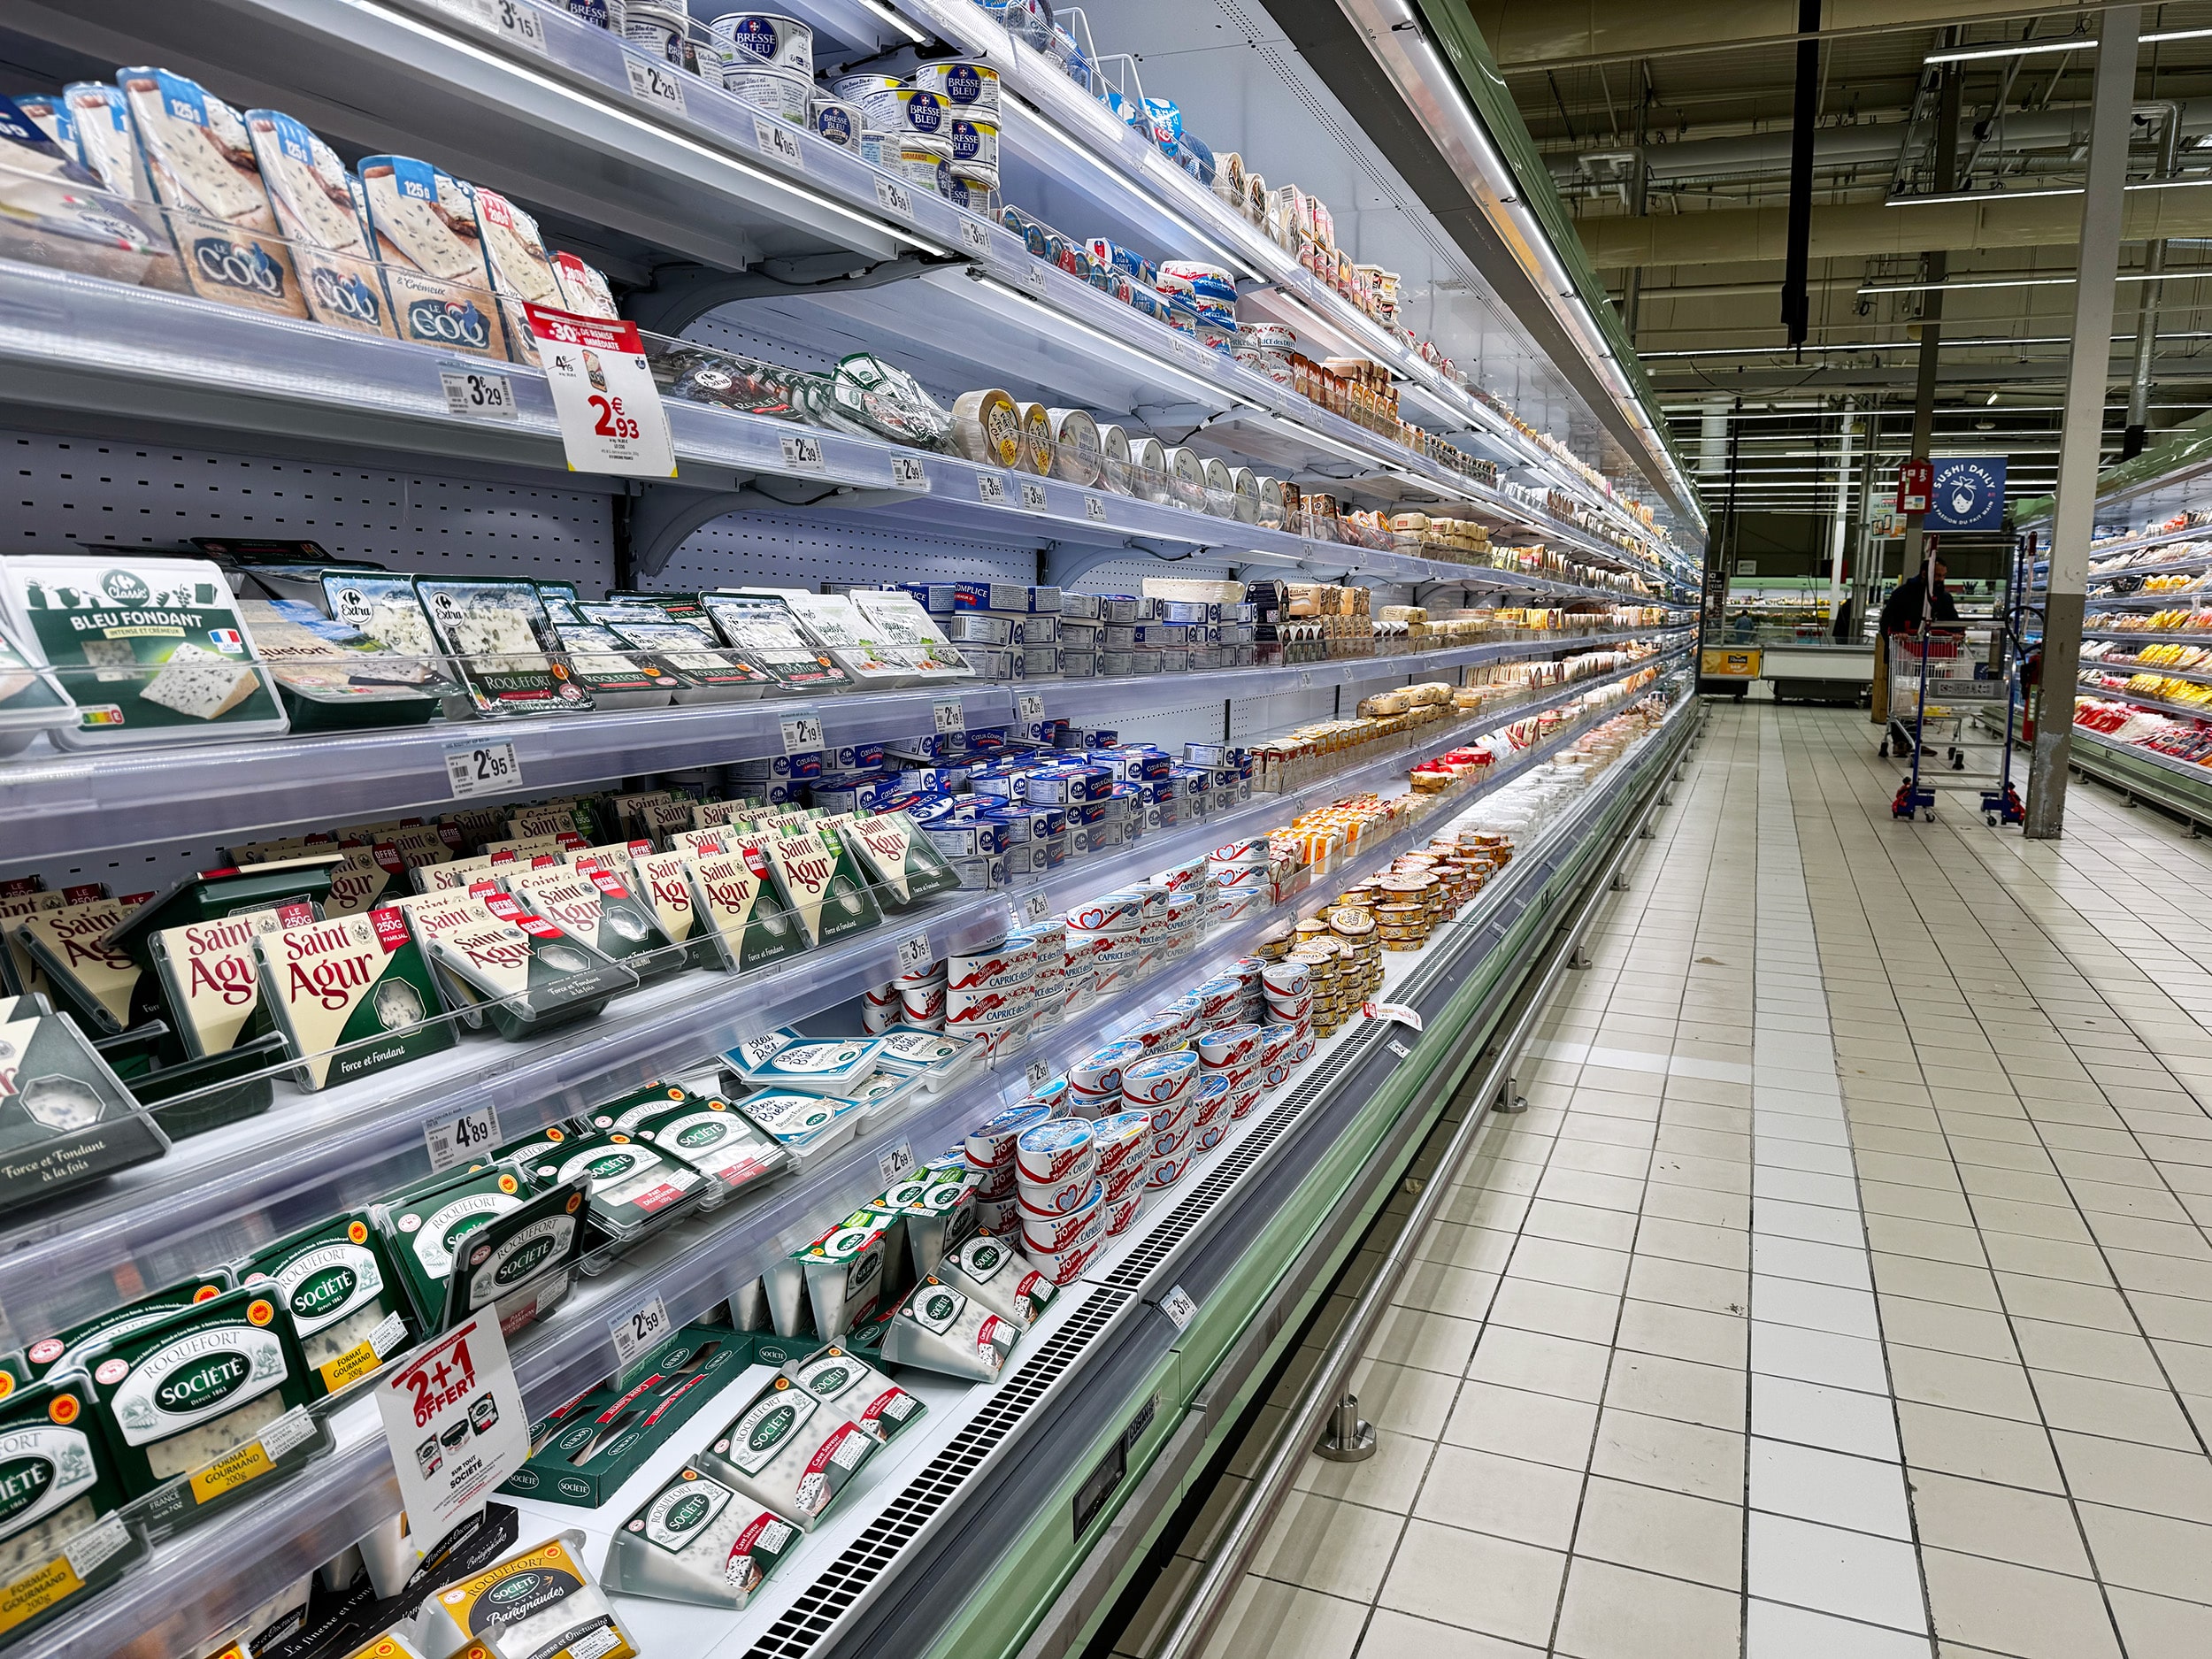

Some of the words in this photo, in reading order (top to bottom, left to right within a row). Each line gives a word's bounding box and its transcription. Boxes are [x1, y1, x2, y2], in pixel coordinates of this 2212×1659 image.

[570, 3, 608, 19] BRESSE
[736, 33, 776, 44] BRESSE
[741, 42, 771, 54] BLEU
[948, 77, 980, 88] BRESSE
[952, 86, 975, 96] BLEU
[824, 113, 848, 126] BRESSE
[910, 105, 941, 118] BRESSE
[915, 114, 937, 125] BLEU
[827, 122, 845, 131] BLEU
[197, 246, 280, 297] COQ
[404, 279, 446, 297] Crémeux
[314, 273, 379, 324] COQ
[429, 303, 442, 314] LE
[411, 307, 484, 348] COQ
[590, 329, 614, 341] REMISE
[1933, 464, 1964, 489] SUSHI
[1969, 464, 1996, 489] DAILY
[1932, 501, 1938, 511] LA
[1935, 509, 1957, 525] PASSION
[1970, 514, 1982, 524] FAIT
[1983, 501, 1994, 516] MAIN
[108, 584, 148, 600] Classic
[342, 603, 371, 619] Extra
[435, 607, 463, 622] Extra
[70, 613, 119, 631] BLEU
[123, 611, 203, 628] FONDANT
[109, 628, 138, 637] INTENSE
[485, 674, 552, 690] ROQUEFORT
[440, 827, 460, 838] OFFRE
[520, 818, 560, 839] Saint
[854, 818, 887, 837] Saint
[375, 849, 397, 860] OFFRE
[630, 843, 650, 856] OFFRE
[777, 837, 814, 860] Saint
[863, 832, 906, 861] Agur
[745, 854, 764, 865] OFFRE
[593, 874, 616, 887] OFFRE
[700, 860, 736, 883] Saint
[782, 855, 831, 894] Agur
[538, 883, 584, 906] Saint
[1180, 880, 1199, 892] CAPRICE
[488, 898, 515, 913] OFFRE
[705, 879, 750, 914] Agur
[288, 908, 300, 917] LE
[380, 911, 392, 921] LE
[419, 905, 472, 933] Saint
[546, 899, 605, 932] Agur
[50, 908, 120, 940] Saint
[376, 918, 403, 933] 250G
[520, 918, 549, 932] OFFRE
[840, 919, 856, 929] Fondant
[185, 917, 253, 956] Saint
[283, 921, 351, 961] Saint
[383, 933, 408, 943] FAMILIAL
[454, 927, 506, 951] Saint
[465, 941, 536, 969] Agur
[748, 952, 761, 962] Force
[765, 944, 785, 956] Fondant
[1098, 949, 1124, 961] CAPRICE
[287, 952, 373, 1010] Agur
[978, 966, 991, 978] Offre
[989, 973, 1018, 987] CAPRICE
[1018, 971, 1028, 979] des
[987, 1007, 1016, 1021] CAPRICE
[1016, 1005, 1025, 1014] des
[342, 1060, 362, 1073] Force
[364, 1056, 373, 1066] et
[373, 1045, 406, 1064] Fondant
[1144, 1044, 1168, 1057] CAPRICE
[1200, 1104, 1210, 1115] 70
[680, 1123, 724, 1148] SOCIÉTÉ
[995, 1142, 1006, 1156] 70
[1102, 1152, 1112, 1164] 70
[1126, 1151, 1148, 1165] CAPRICE
[1, 1162, 38, 1179] Force
[40, 1156, 52, 1168] et
[53, 1140, 106, 1164] Fondant
[1052, 1158, 1063, 1171] 70
[993, 1173, 1005, 1187] 70
[1109, 1178, 1118, 1189] 70
[432, 1196, 497, 1230] ROQUEFORT
[1002, 1210, 1014, 1222] 70
[1114, 1210, 1124, 1223] 70
[496, 1218, 559, 1261] ROQUEFORT
[1056, 1228, 1067, 1242] 70
[280, 1247, 346, 1290] ROQUEFORT
[499, 1240, 550, 1279] SOCIÉTÉ
[1060, 1259, 1071, 1272] 70
[294, 1271, 353, 1312] SOCIÉTÉ
[144, 1331, 241, 1379] ROQUEFORT
[336, 1348, 363, 1367] FORMAT
[762, 1349, 785, 1360] SOCIÉTÉ
[333, 1351, 371, 1379] GOURMAND
[347, 1367, 364, 1380] 200g
[161, 1357, 243, 1405] SOCIÉTÉ
[406, 1338, 475, 1417] 2+1
[813, 1368, 846, 1394] SOCIÉTÉ
[211, 1386, 227, 1397] 1863
[415, 1370, 476, 1428] OFFERT
[736, 1396, 781, 1442] ROQUEFORT
[752, 1408, 792, 1448] SOCIÉTÉ
[812, 1448, 826, 1467] Cave
[823, 1433, 841, 1455] Saveur
[205, 1453, 260, 1485] GOURMAND
[449, 1458, 484, 1489] SOCIÉTÉ
[451, 1463, 463, 1478] SUR
[462, 1454, 477, 1469] TOUT
[225, 1471, 249, 1487] 200g
[652, 1485, 692, 1524] ROQUEFORT
[669, 1494, 705, 1530] SOCIÉTÉ
[736, 1536, 748, 1551] Cave
[745, 1523, 759, 1541] Saveur
[11, 1568, 53, 1595] FORMAT
[467, 1557, 545, 1598] ROQUEFORT
[2, 1572, 66, 1613] GOURMAND
[492, 1575, 536, 1601] SOCIÉTÉ
[487, 1586, 565, 1627] Baragnaudes
